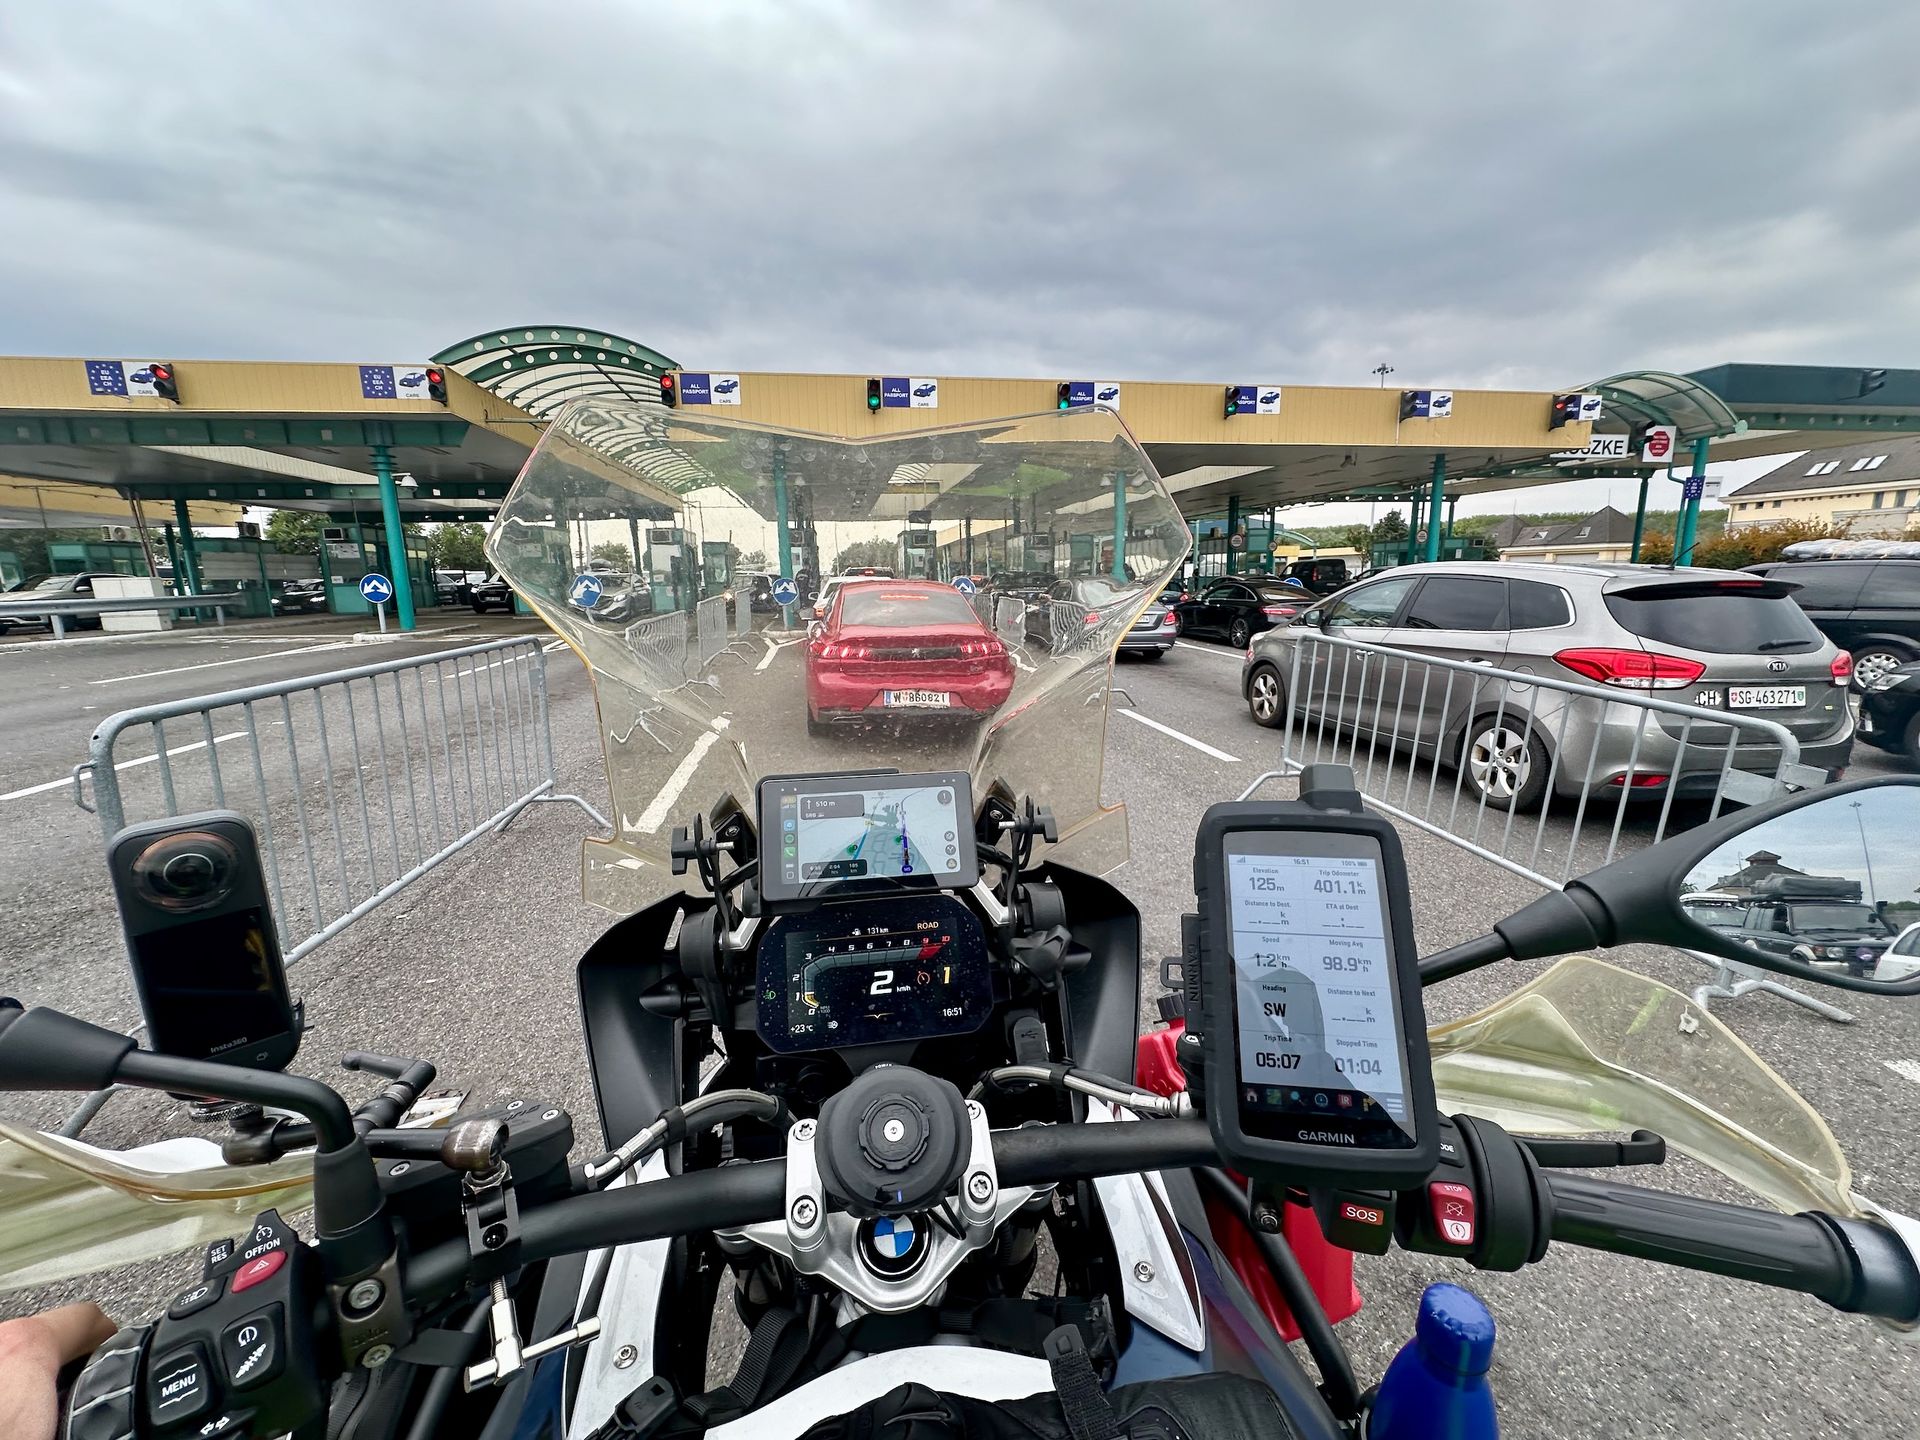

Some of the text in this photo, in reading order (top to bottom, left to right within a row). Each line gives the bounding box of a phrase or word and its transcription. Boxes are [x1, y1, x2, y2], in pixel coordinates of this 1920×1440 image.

[1772, 662, 1788, 670] KIA
[1700, 691, 1716, 706] CH
[917, 922, 939, 930] ROAD
[793, 974, 800, 982] 2
[944, 966, 950, 984] 1
[1188, 944, 1199, 1002] GARMIN
[870, 970, 894, 995] 2
[1262, 985, 1286, 993] Heading
[796, 992, 800, 1001] 1
[943, 1007, 962, 1017] 16:51
[1263, 1002, 1286, 1017] SW
[1336, 1039, 1362, 1048] Stopped
[1256, 1052, 1301, 1070] 05:07
[1335, 1057, 1382, 1075] 01:04
[1298, 1130, 1355, 1144] GARMIN
[1346, 1206, 1377, 1222] SOS
[211, 1245, 226, 1256] SET
[245, 1238, 280, 1259] OFF/ON
[211, 1252, 227, 1264] RES
[162, 1374, 196, 1397] MENU
